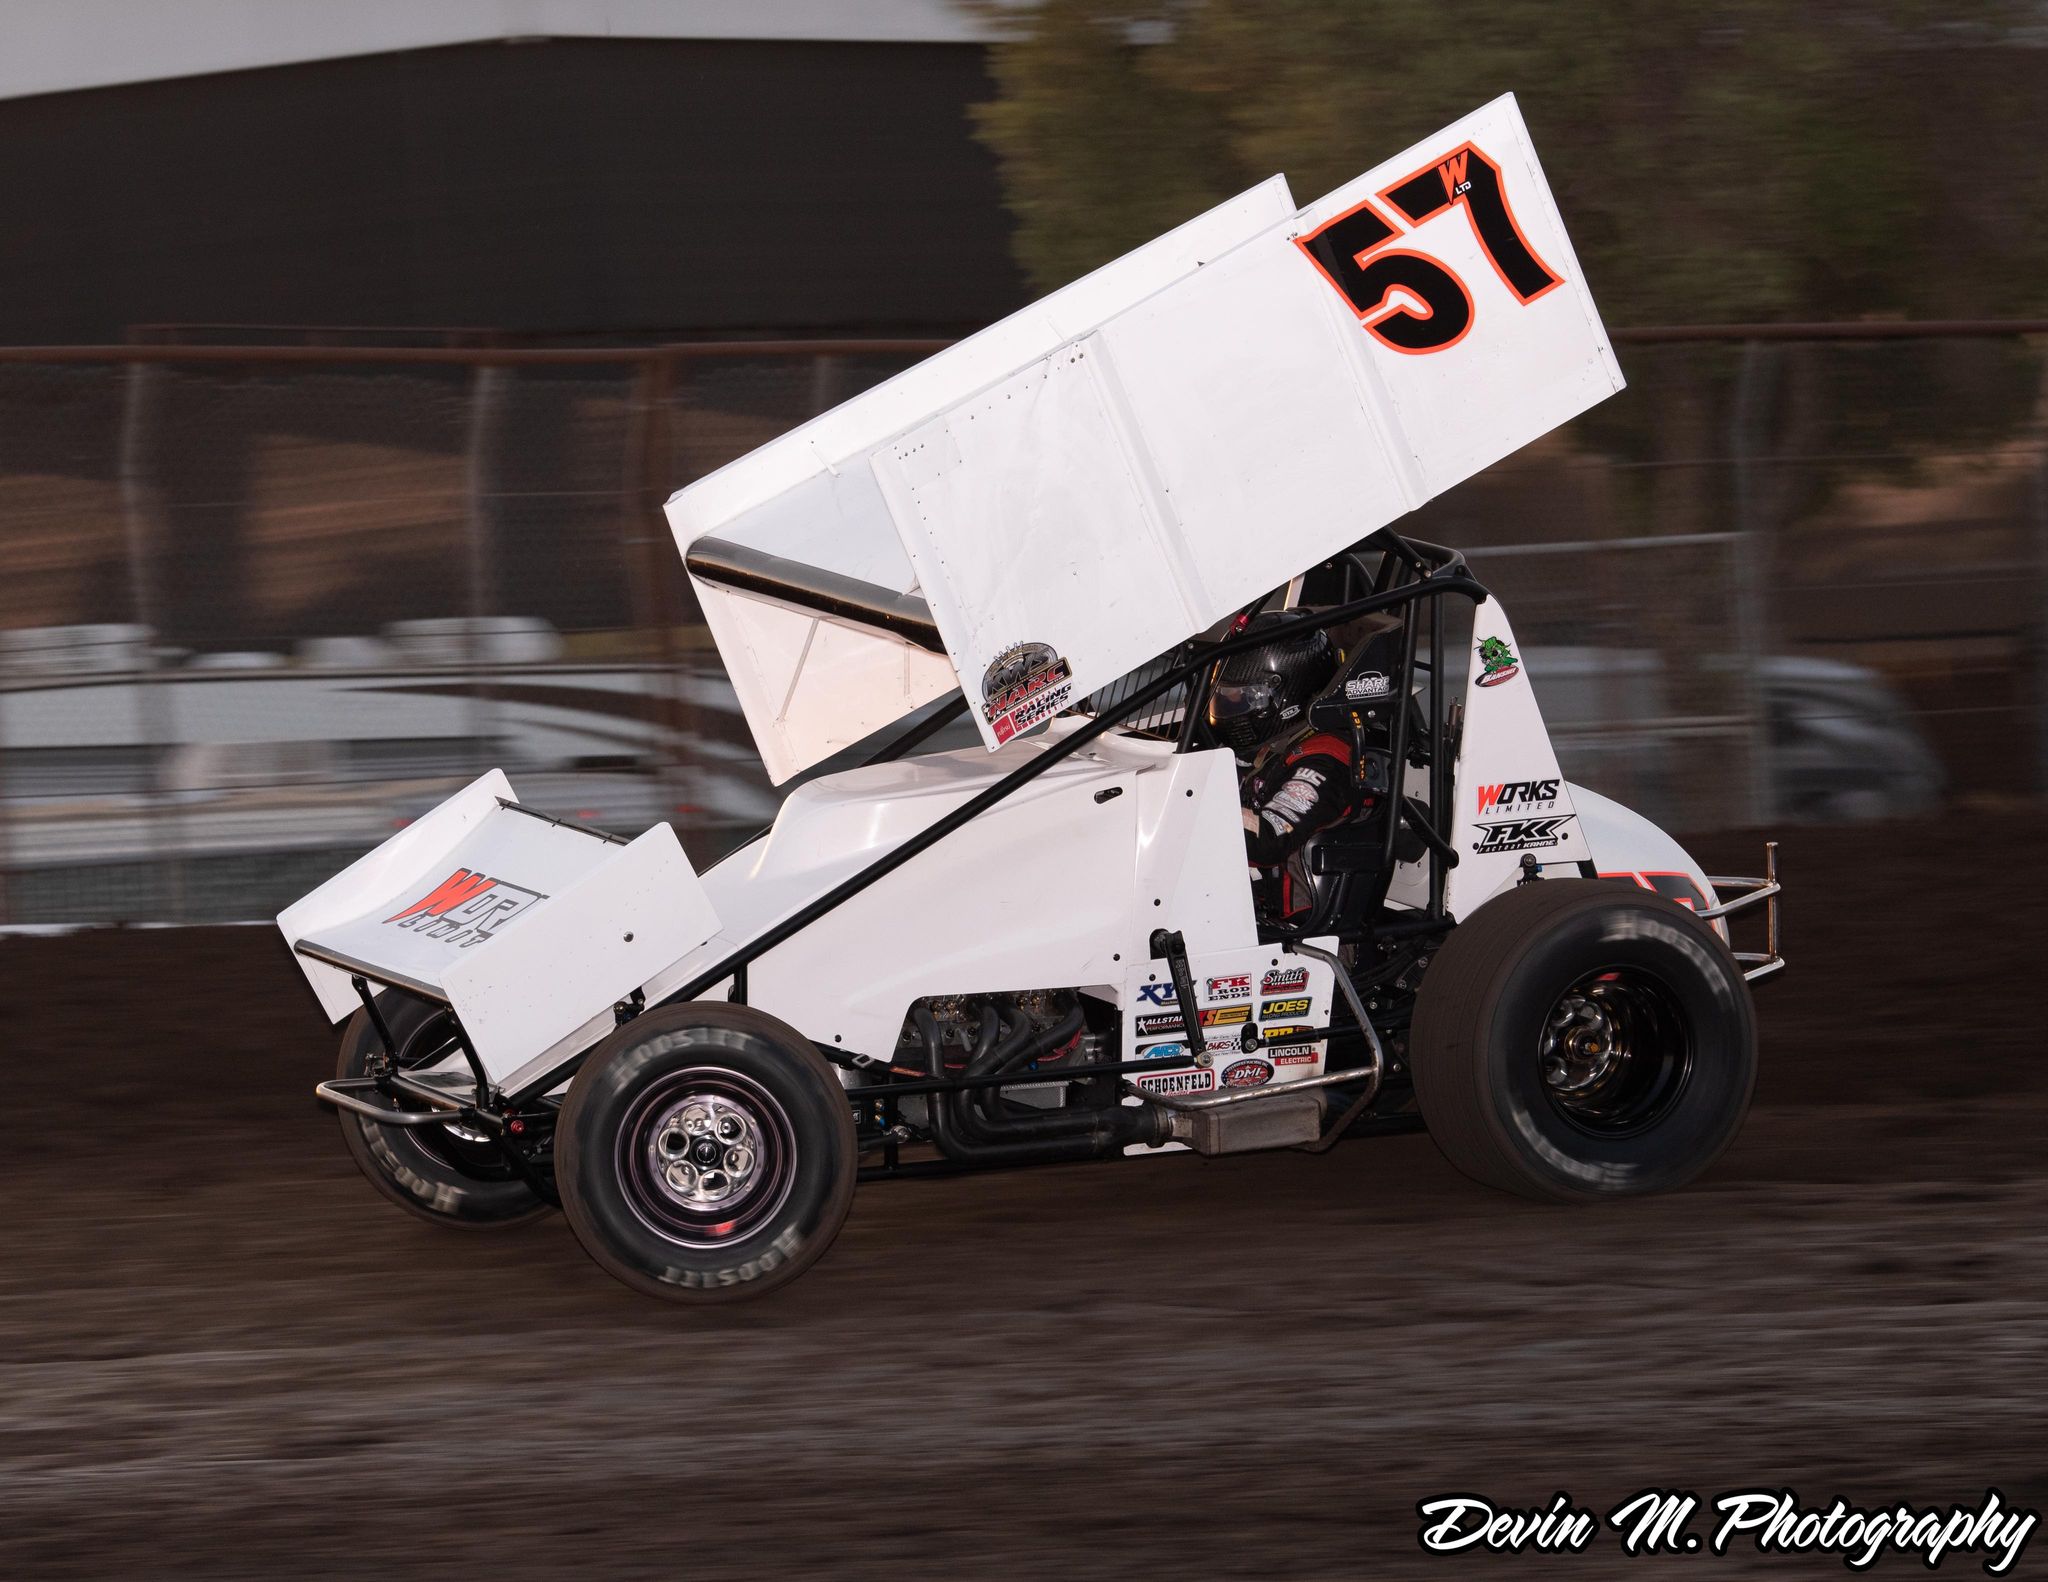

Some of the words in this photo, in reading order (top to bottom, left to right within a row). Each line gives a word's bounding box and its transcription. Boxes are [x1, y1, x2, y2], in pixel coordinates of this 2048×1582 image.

[1455, 181, 1472, 194] LTD
[1293, 140, 1566, 355] 57
[987, 661, 1065, 718] NARC
[1015, 683, 1072, 719] RACING
[1017, 692, 1069, 725] SERIES
[1478, 779, 1560, 815] WORKS
[1485, 801, 1555, 814] LIMITED
[1479, 843, 1521, 853] FACTORY
[1523, 840, 1556, 849] KAHNE
[1212, 976, 1250, 989] FK
[1262, 968, 1306, 984] Smith
[1208, 992, 1250, 1001] ENDS
[1218, 986, 1250, 995] ROD
[1263, 999, 1308, 1014] JOES
[1270, 1046, 1310, 1057] LINCOLN
[1280, 1056, 1312, 1065] ELECTRIC
[1235, 1067, 1261, 1078] DMI
[1141, 1073, 1211, 1093] SCHOENFELD
